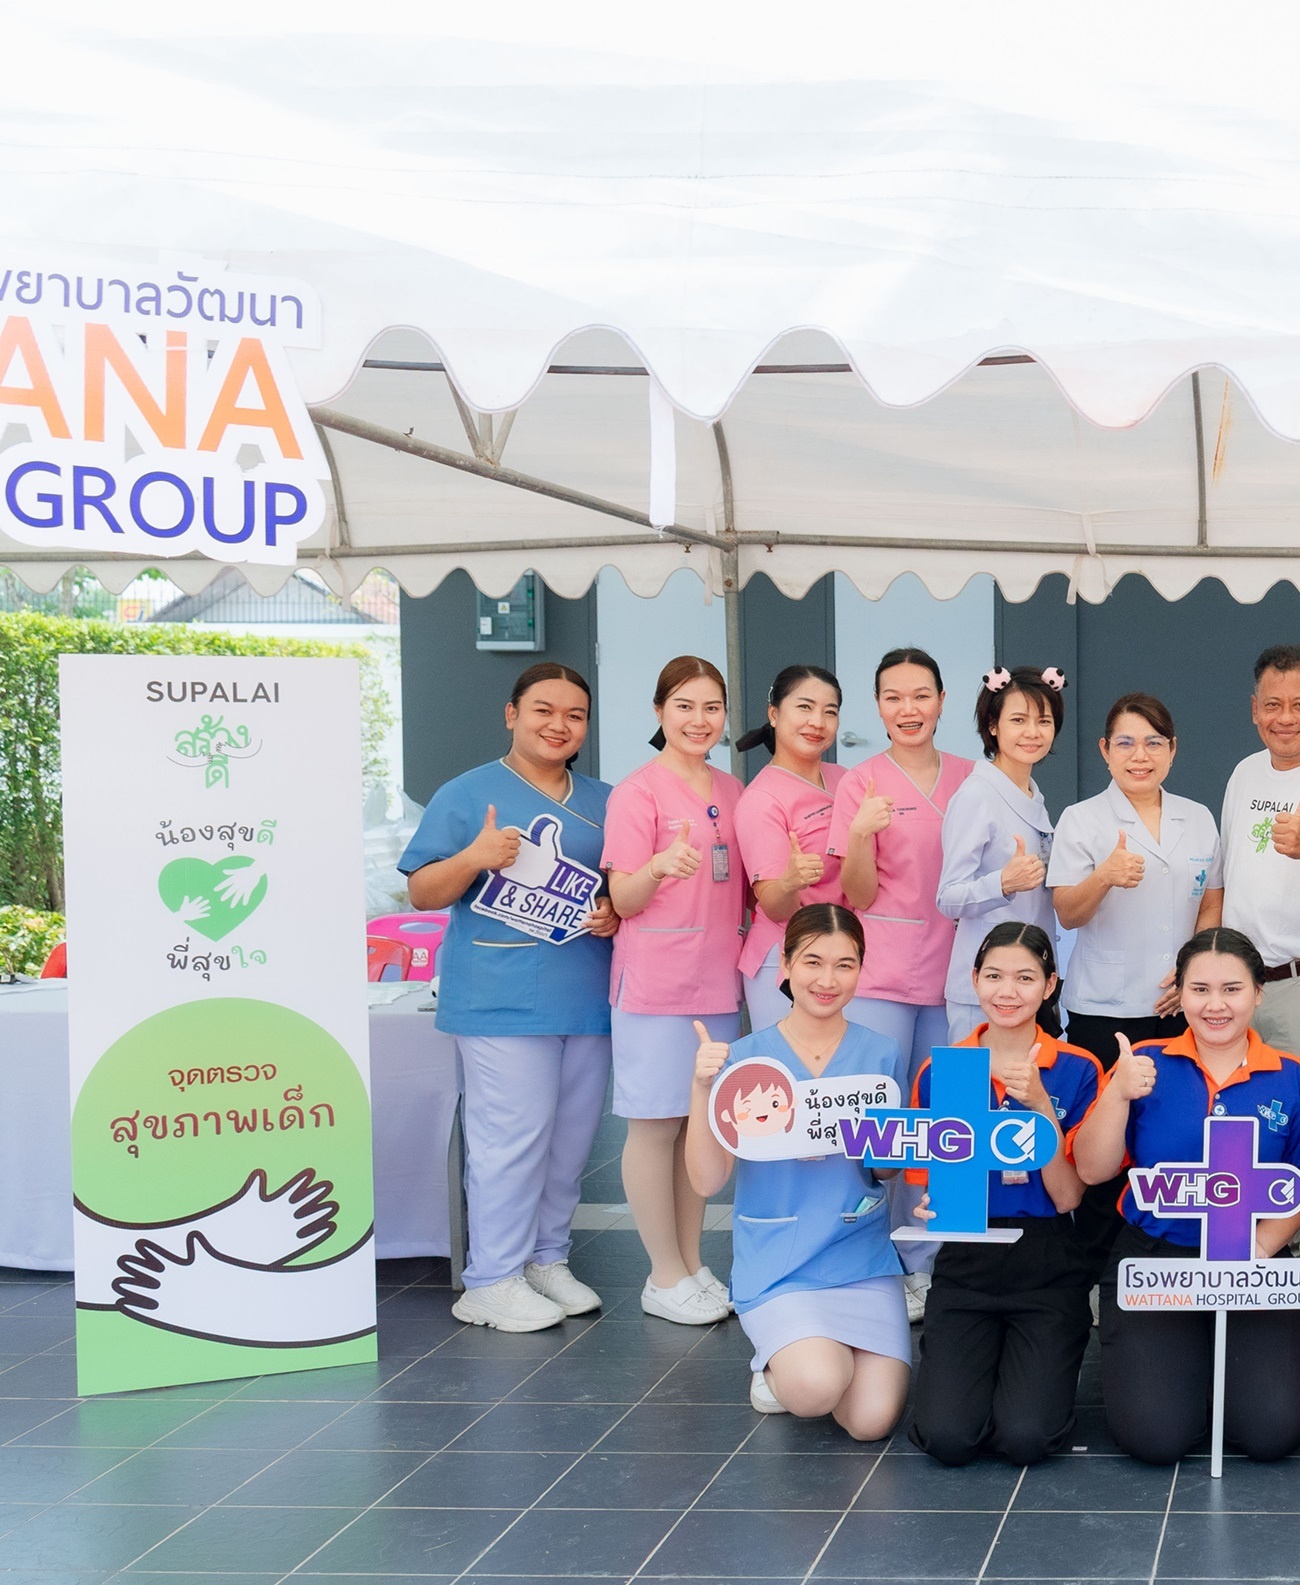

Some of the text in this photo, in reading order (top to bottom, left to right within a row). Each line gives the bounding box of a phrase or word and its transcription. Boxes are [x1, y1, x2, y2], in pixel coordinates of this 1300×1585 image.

[5, 460, 308, 547] GROUP
[146, 680, 280, 703] SUPALAI
[1250, 799, 1294, 813] SUPALAI
[155, 819, 278, 851] น้องสุขดี
[549, 866, 594, 902] LIKE
[500, 885, 587, 929] & SHARE
[166, 937, 267, 981] พี่สุขใจ
[168, 1063, 277, 1092] จุดตรวจ
[805, 1082, 887, 1115] น้องสุขดี
[110, 1084, 335, 1159] สุขภาพเด็ก
[838, 1117, 975, 1163] WHG
[1136, 1171, 1241, 1208] WHG
[1125, 1294, 1193, 1306] WATTANA
[1196, 1293, 1261, 1305] HOSPITAL
